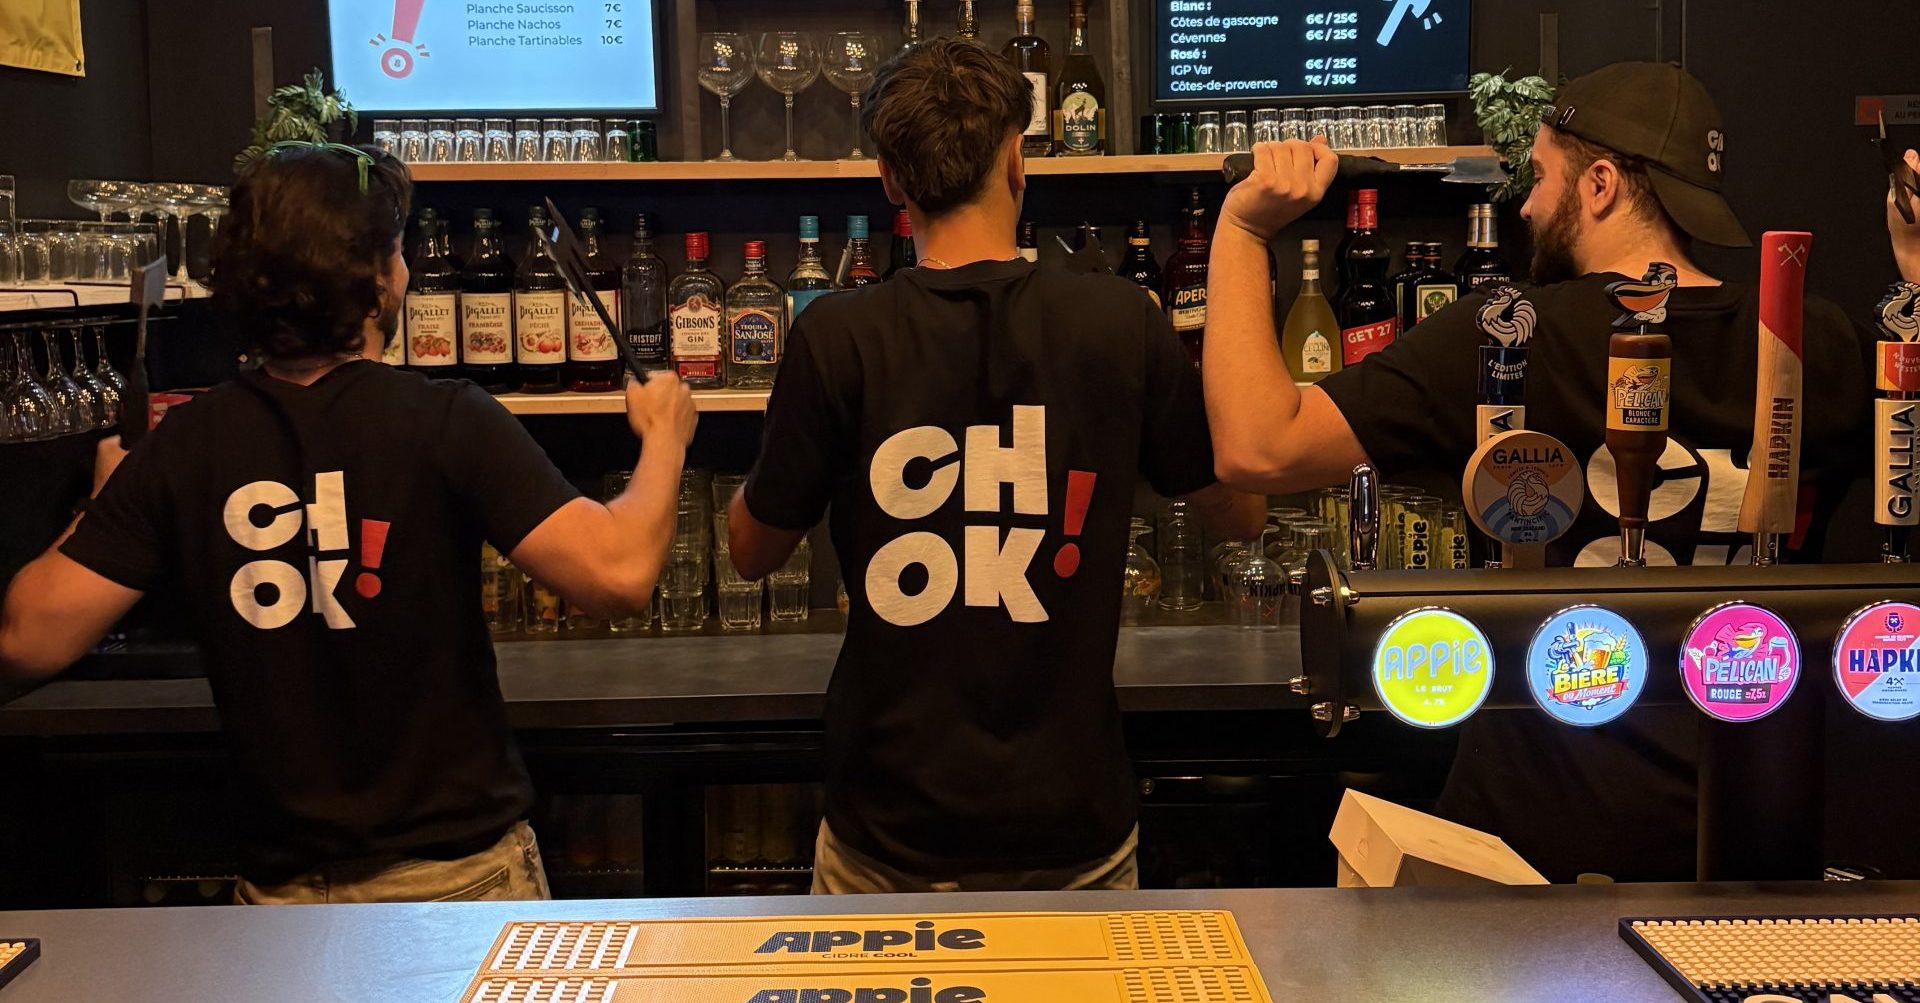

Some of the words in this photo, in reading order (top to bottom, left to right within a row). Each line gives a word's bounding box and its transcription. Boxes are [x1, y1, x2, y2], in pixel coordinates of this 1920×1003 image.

[467, 3, 514, 14] Planche
[515, 2, 575, 14] Saucisson
[605, 3, 622, 13] 7€
[1170, 0, 1205, 11] Blanc
[467, 19, 515, 30] Planche
[517, 19, 562, 30] Nachos
[606, 19, 623, 29] 7€
[1170, 16, 1203, 28] Côtes
[1205, 15, 1220, 27] de
[1222, 15, 1279, 29] gascogne
[1306, 13, 1324, 24] 6€
[1333, 12, 1358, 24] 25€
[468, 36, 517, 46] Planche
[518, 35, 583, 46] Tartinables
[601, 35, 624, 45] 10€
[1170, 32, 1227, 44] Cévennes
[1306, 29, 1324, 41] 6€
[1333, 28, 1358, 40] 25€
[1170, 47, 1201, 60] Rosé
[1170, 64, 1192, 76] IGP
[1193, 63, 1213, 75] Var
[1305, 58, 1324, 70] 6€
[1332, 57, 1357, 69] 25€
[1304, 74, 1323, 86] 7€
[1331, 73, 1357, 85] 30€
[1065, 124, 1096, 132] DOLIN
[1175, 287, 1208, 306] APER
[675, 315, 715, 330] GIBSON'S
[629, 334, 662, 344] ERISTOFF
[687, 335, 704, 343] GIN
[1347, 328, 1375, 344] GET
[1377, 322, 1392, 337] 27
[1767, 397, 1794, 480] HAPKIN
[870, 404, 1049, 520] CH
[1492, 447, 1564, 465] GALLIA
[1887, 403, 1917, 520] GALLIA
[1576, 684, 1617, 700] Moment
[1711, 688, 1742, 699] ROUGE
